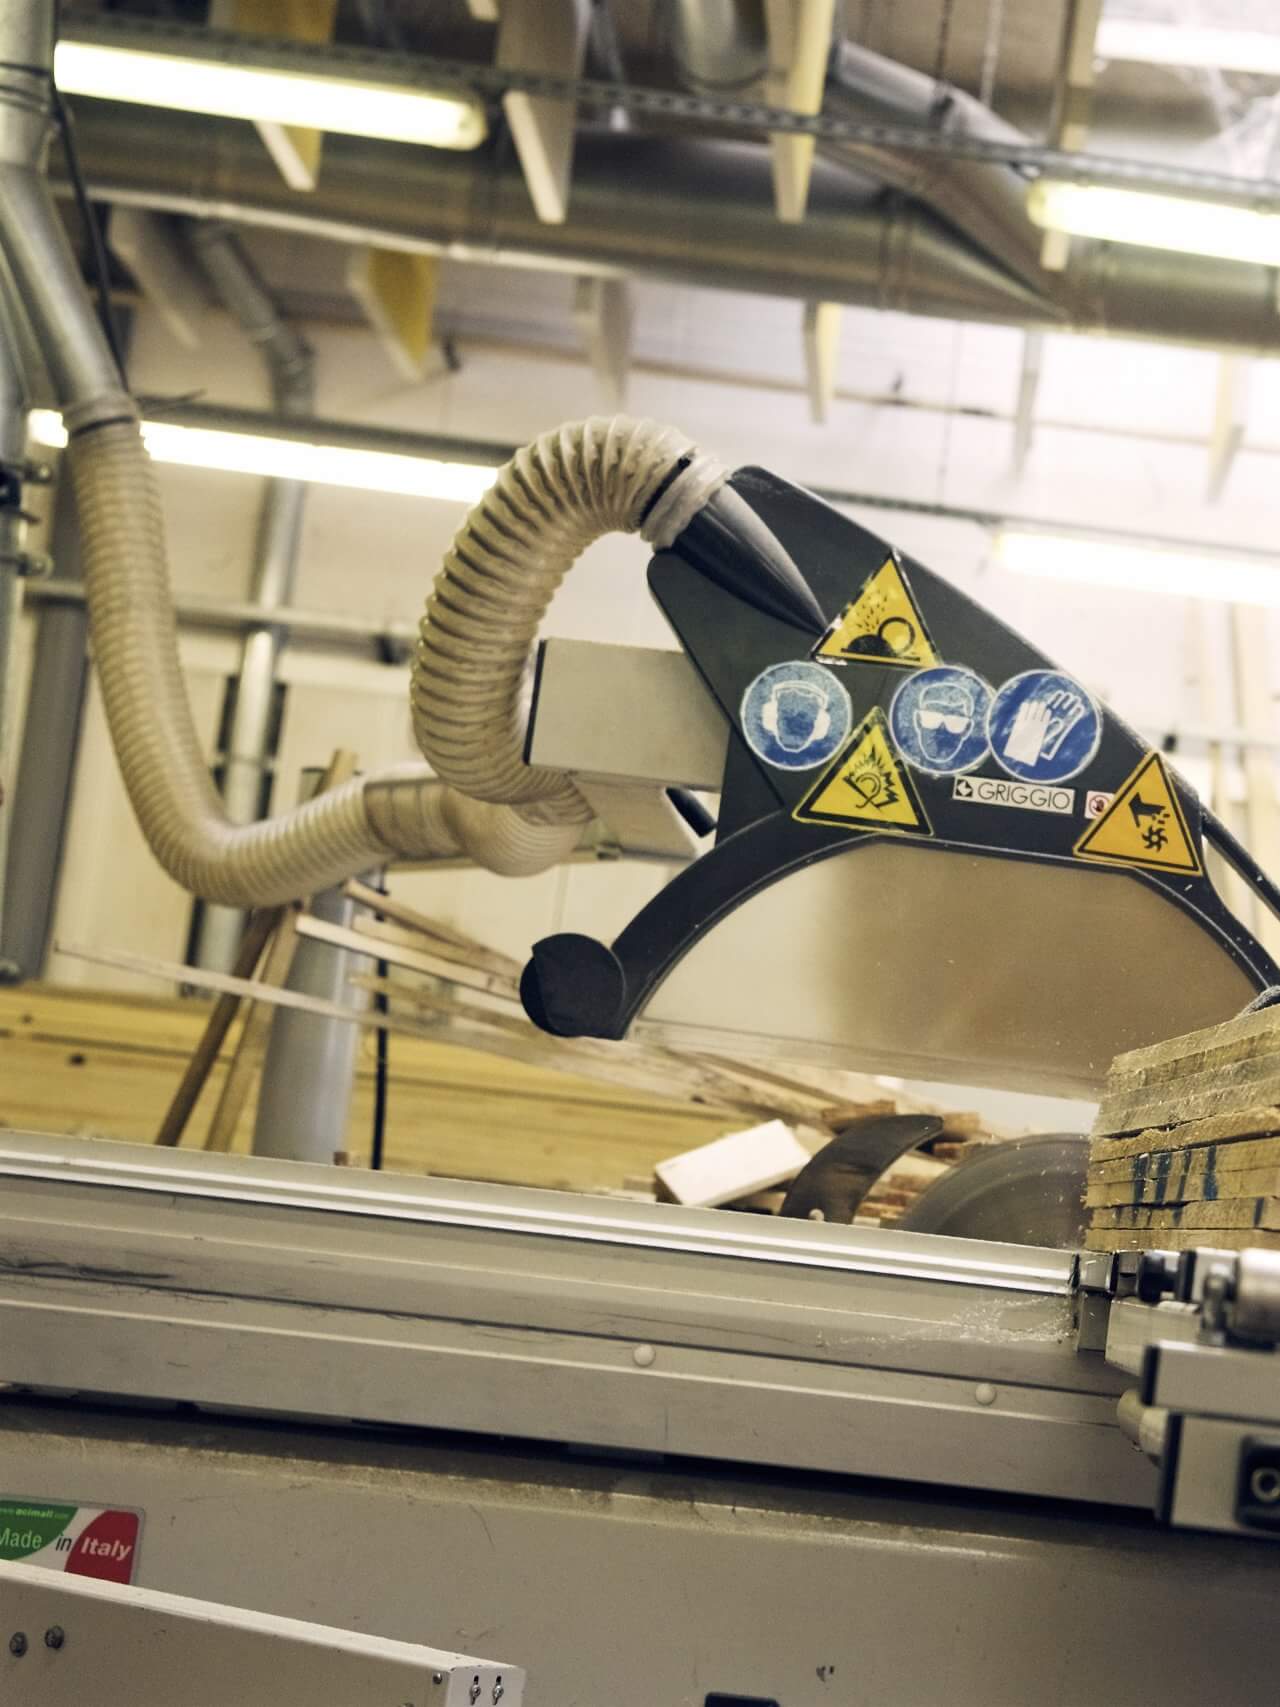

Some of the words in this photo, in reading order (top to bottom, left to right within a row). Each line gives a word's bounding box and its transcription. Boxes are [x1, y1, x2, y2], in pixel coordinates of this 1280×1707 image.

[977, 781, 1071, 810] GRIGGIO
[55, 1533, 72, 1551] in
[81, 1537, 133, 1561] Italy
